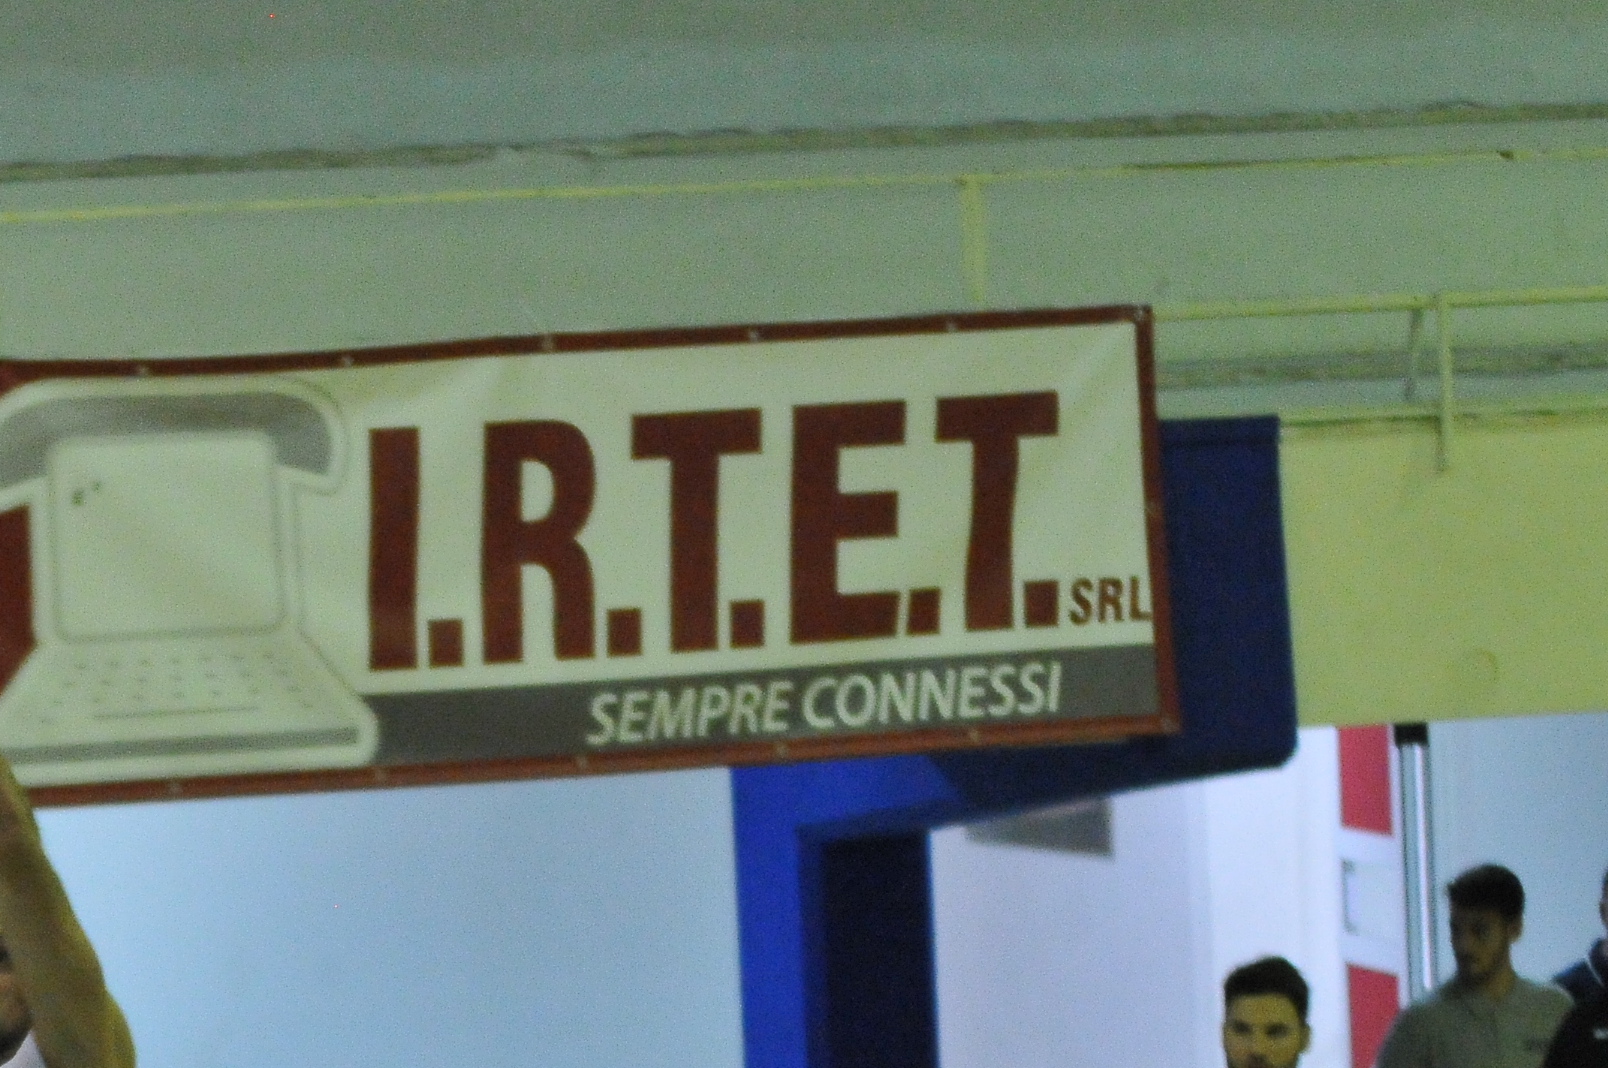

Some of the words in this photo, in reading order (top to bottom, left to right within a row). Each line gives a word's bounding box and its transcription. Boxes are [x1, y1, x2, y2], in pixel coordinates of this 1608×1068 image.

[368, 390, 1060, 671] I.R.T.E.T.
[1069, 576, 1152, 625] SRL
[587, 679, 793, 746] SEMPRE
[801, 660, 1062, 730] CONNESSI
